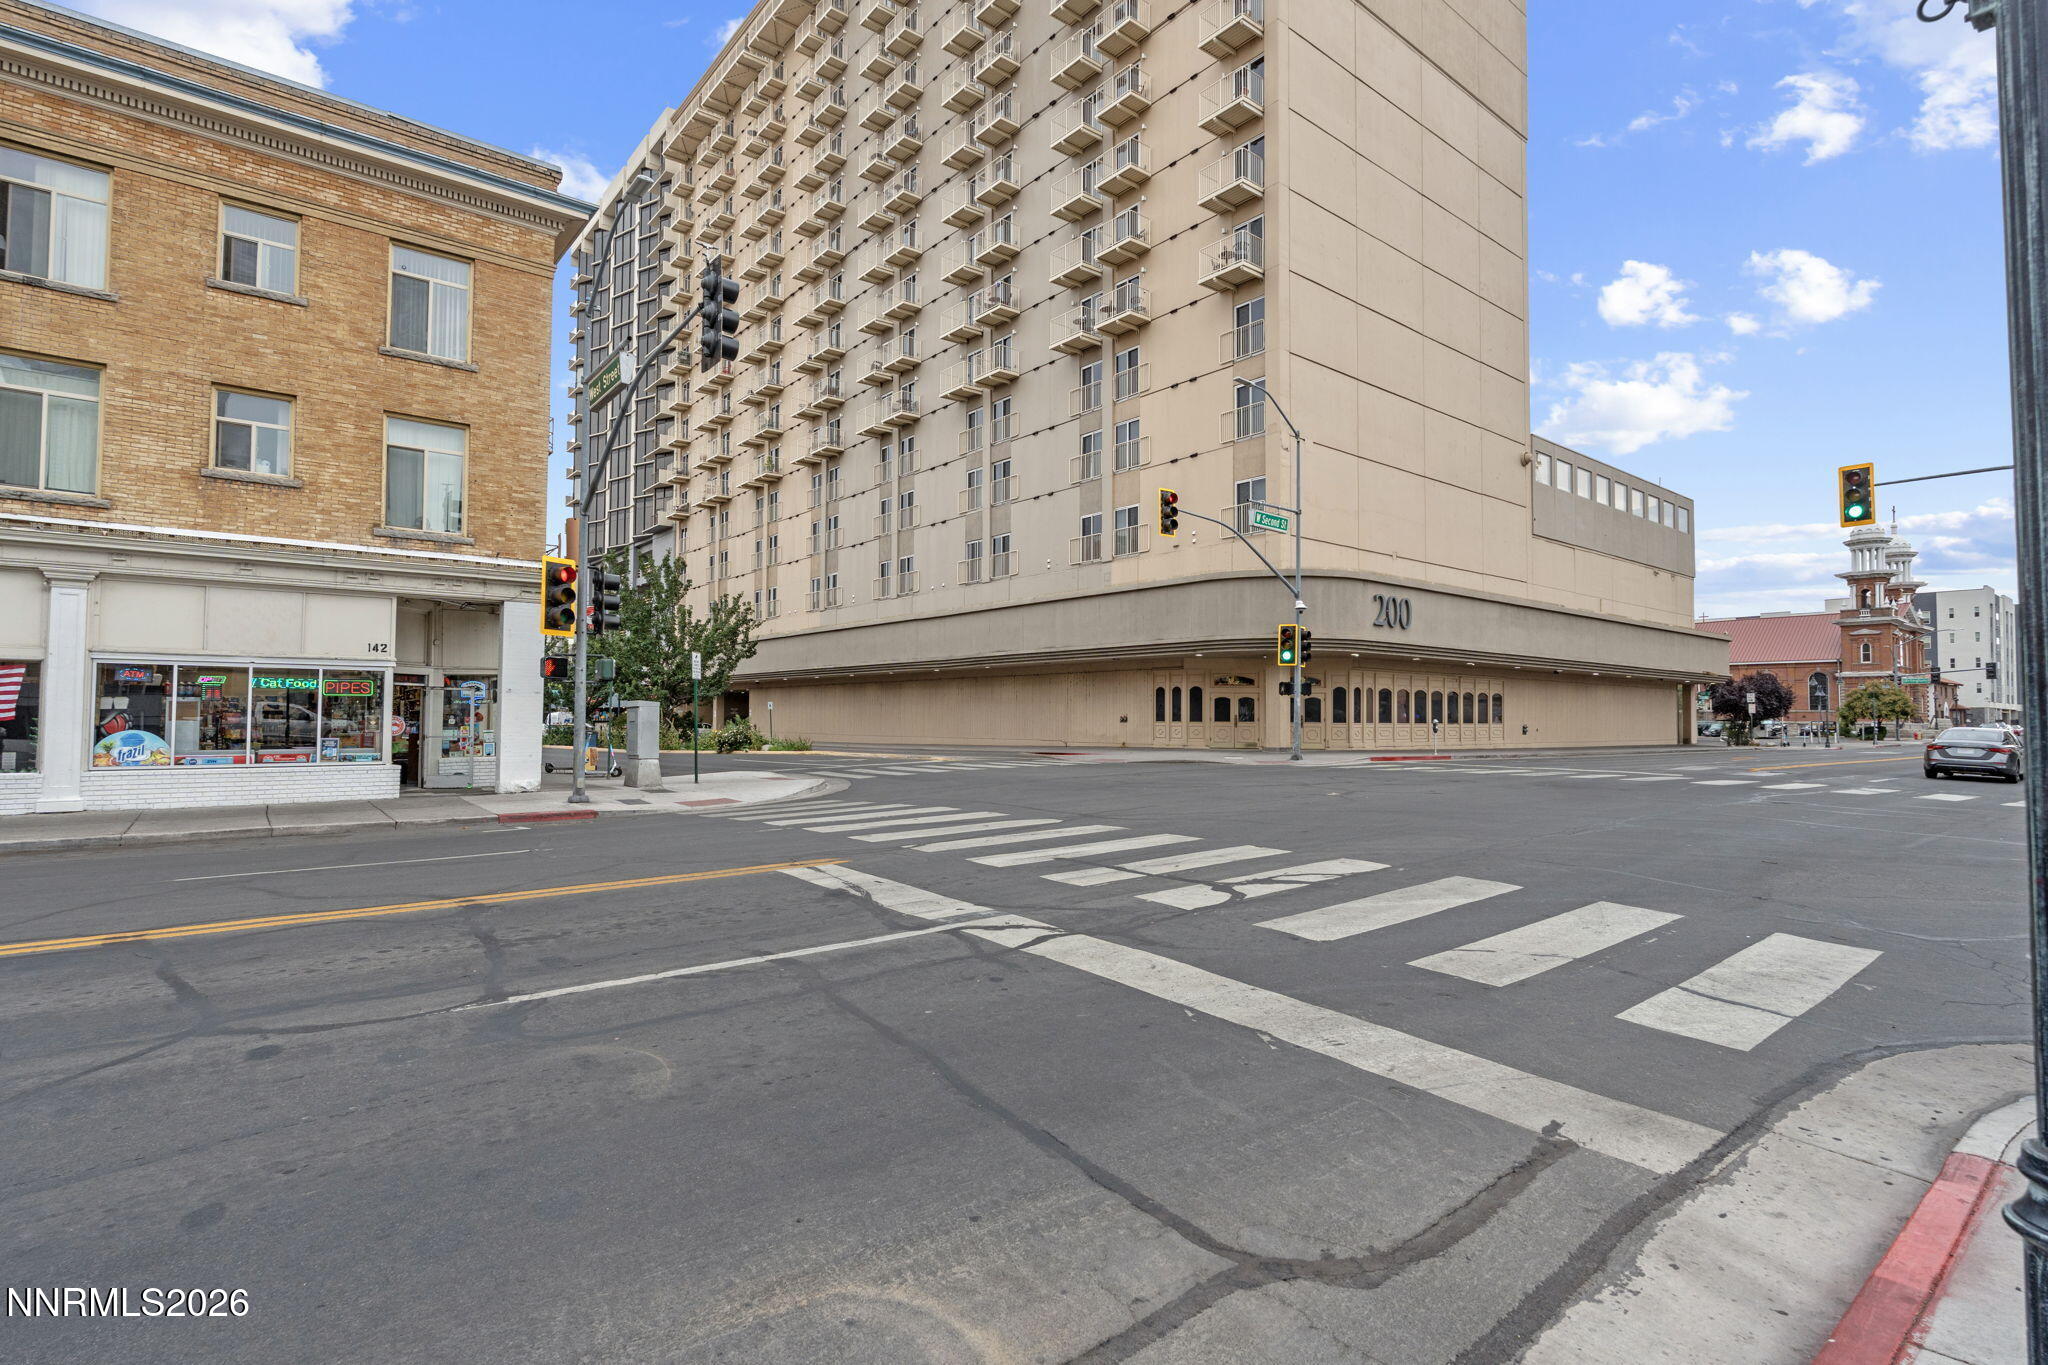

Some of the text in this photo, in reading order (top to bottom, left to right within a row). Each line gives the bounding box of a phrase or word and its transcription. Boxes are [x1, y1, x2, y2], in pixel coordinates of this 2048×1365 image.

[602, 362, 620, 389] Street
[1261, 514, 1280, 528] Second
[1281, 519, 1287, 529] St
[1373, 594, 1412, 630] 200
[368, 643, 388, 653] 142
[124, 670, 145, 678] ATM
[260, 678, 283, 688] Cat
[285, 678, 317, 688] Food
[325, 682, 372, 694] PIPES
[117, 744, 145, 762] frazil
